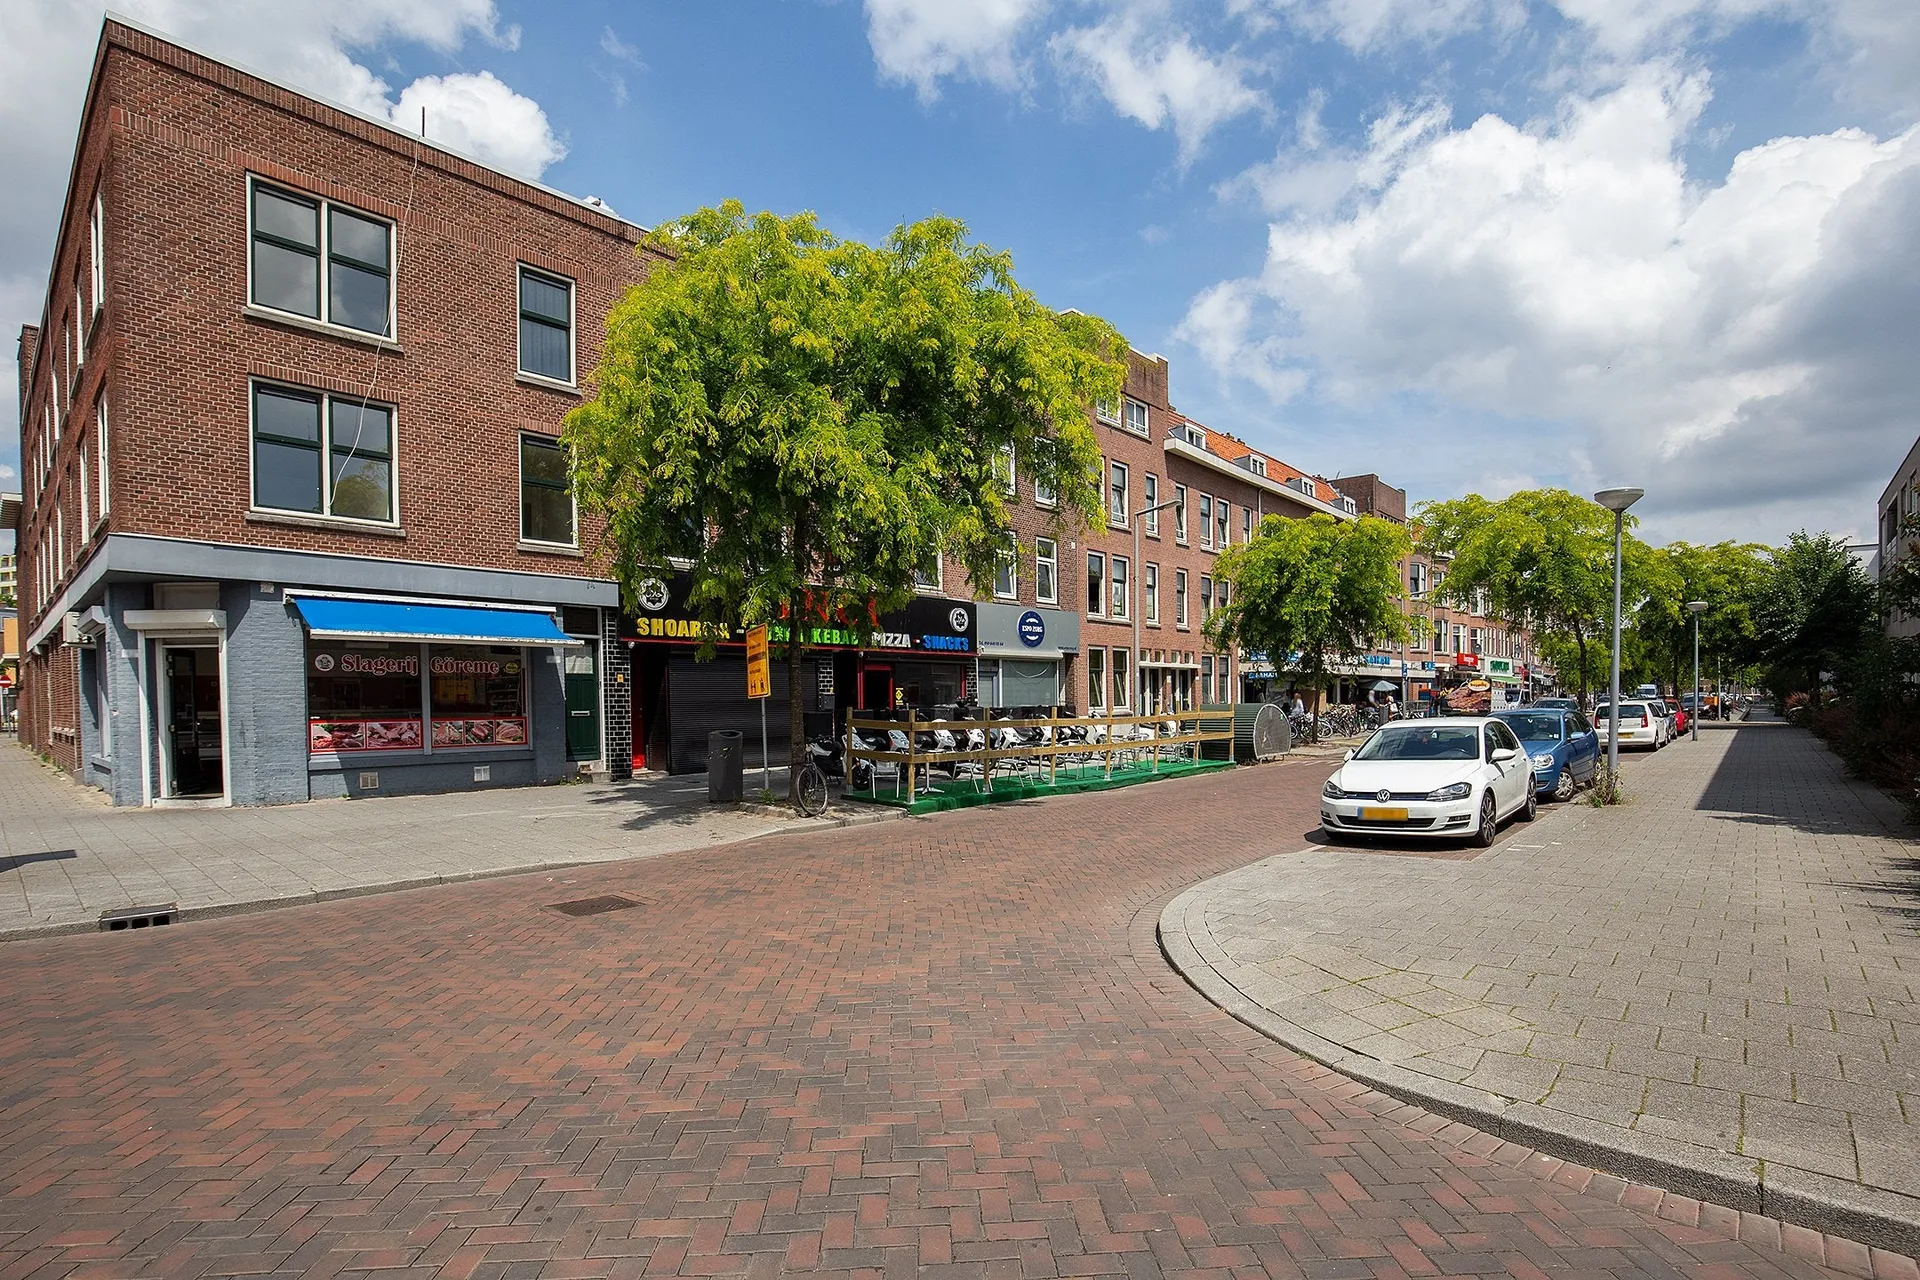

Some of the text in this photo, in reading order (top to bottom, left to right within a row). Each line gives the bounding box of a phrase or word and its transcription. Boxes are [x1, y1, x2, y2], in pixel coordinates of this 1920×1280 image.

[871, 631, 912, 648] PIZZA
[922, 634, 969, 651] SNACKS
[340, 654, 419, 676] Slagerij
[429, 656, 500, 674] Göreme
